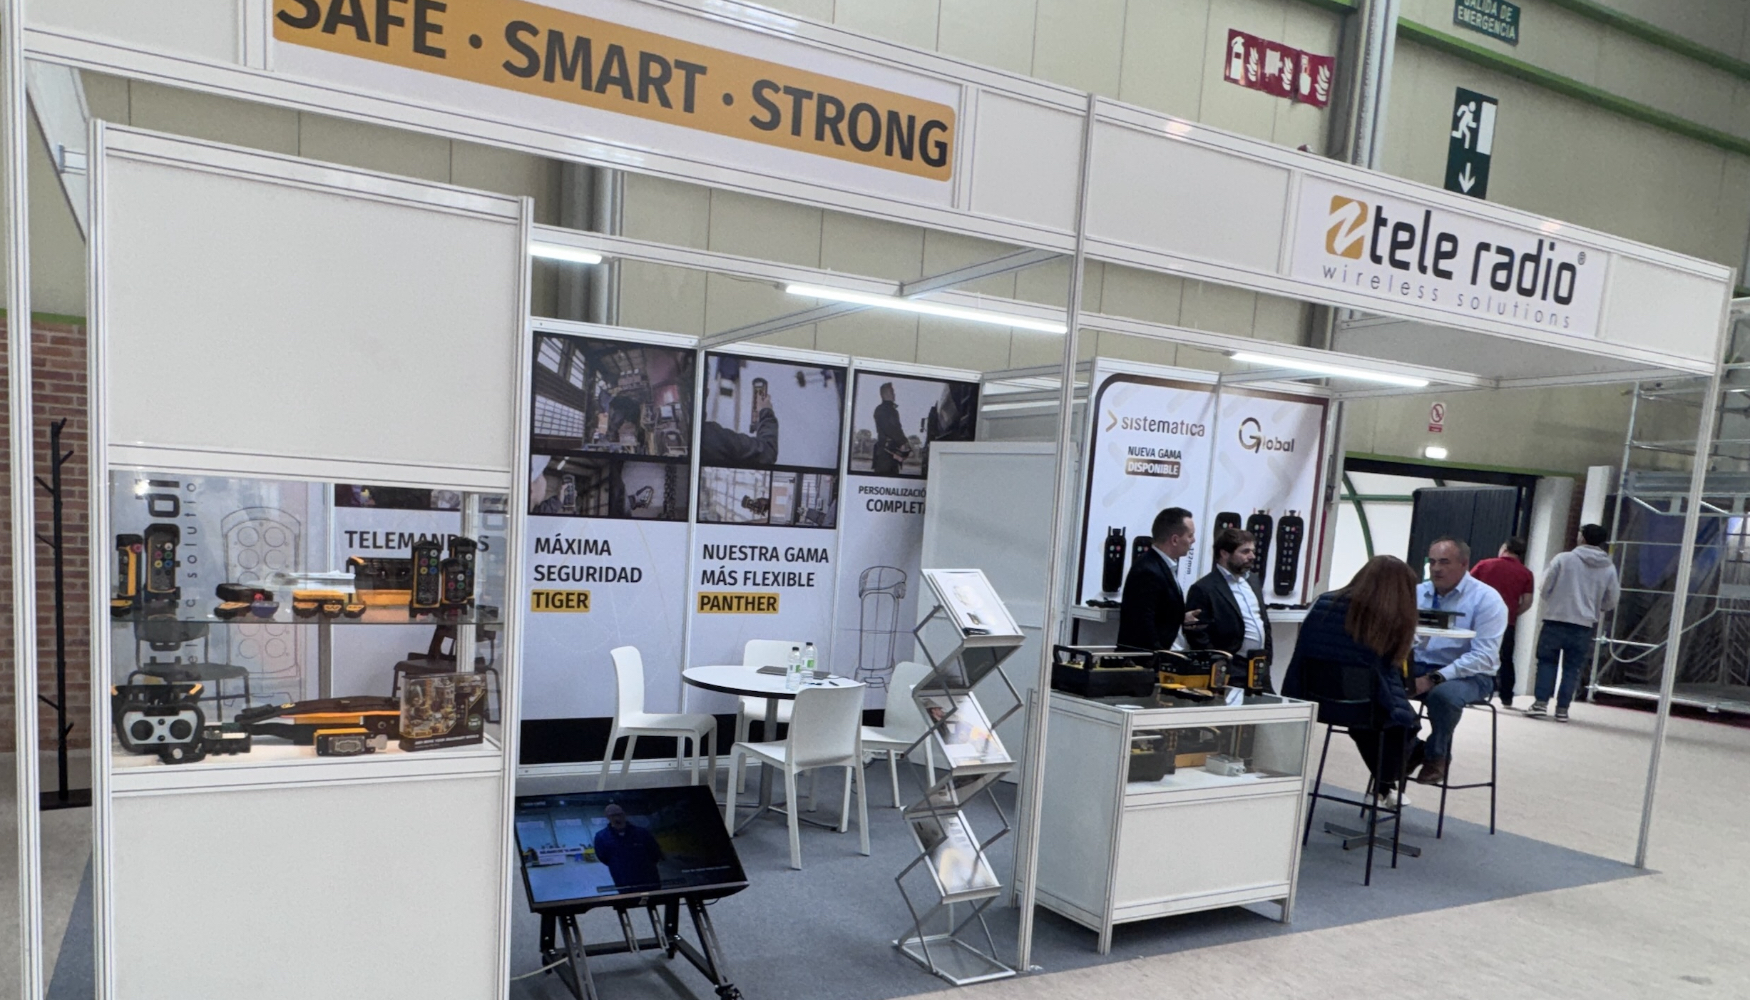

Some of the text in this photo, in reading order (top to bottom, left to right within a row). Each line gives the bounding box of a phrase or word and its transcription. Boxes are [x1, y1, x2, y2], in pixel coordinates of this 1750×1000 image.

[1457, 5, 1516, 39] EMERGENCIA
[1500, 5, 1514, 22] DE
[503, 20, 706, 114] SMART
[750, 79, 949, 168] STRONG
[1370, 204, 1458, 281] tele
[1322, 264, 1570, 329] wireless solutions
[1120, 415, 1205, 438] sistematica
[1127, 446, 1182, 460] NUEVA GAMA
[1127, 461, 1180, 475] DISPONIBLE
[534, 533, 612, 556] MÁXIMA
[702, 543, 830, 564] NUESTRA GAMA
[533, 564, 642, 584] SEGURIDAD
[700, 567, 816, 588] MÁS FLEXIBLE
[532, 591, 589, 610] TIGER
[699, 595, 777, 612] PANTHER
